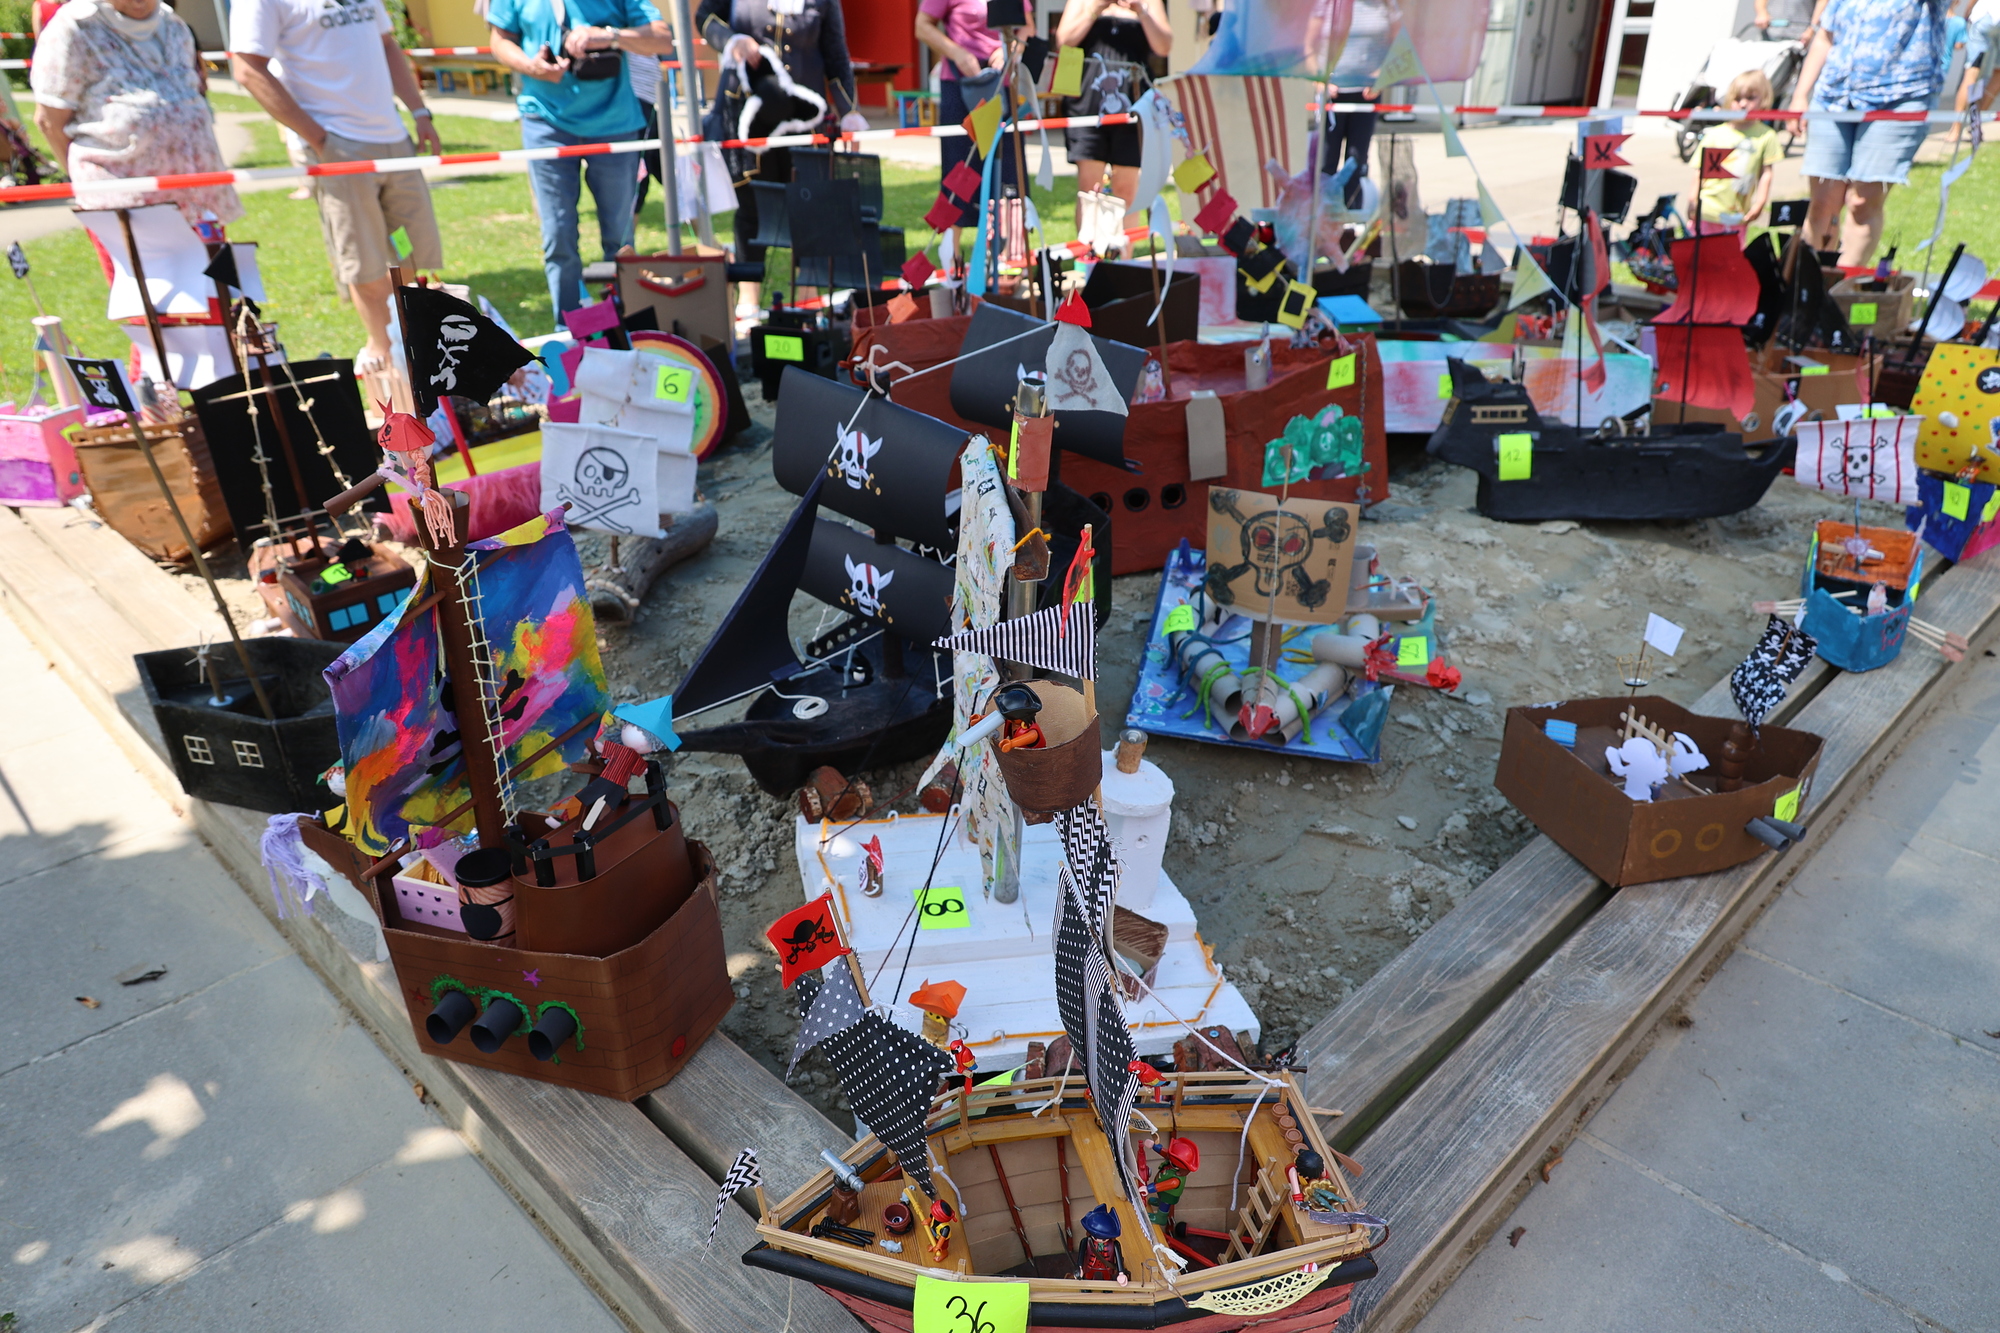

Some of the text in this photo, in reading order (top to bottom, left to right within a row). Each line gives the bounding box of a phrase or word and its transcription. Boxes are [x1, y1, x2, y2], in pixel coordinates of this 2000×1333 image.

[773, 339, 791, 354] 20
[663, 372, 679, 395] 6
[1503, 448, 1522, 463] 12
[1167, 608, 1190, 628] 23
[924, 898, 965, 917] 8
[946, 1296, 996, 1333] 36
